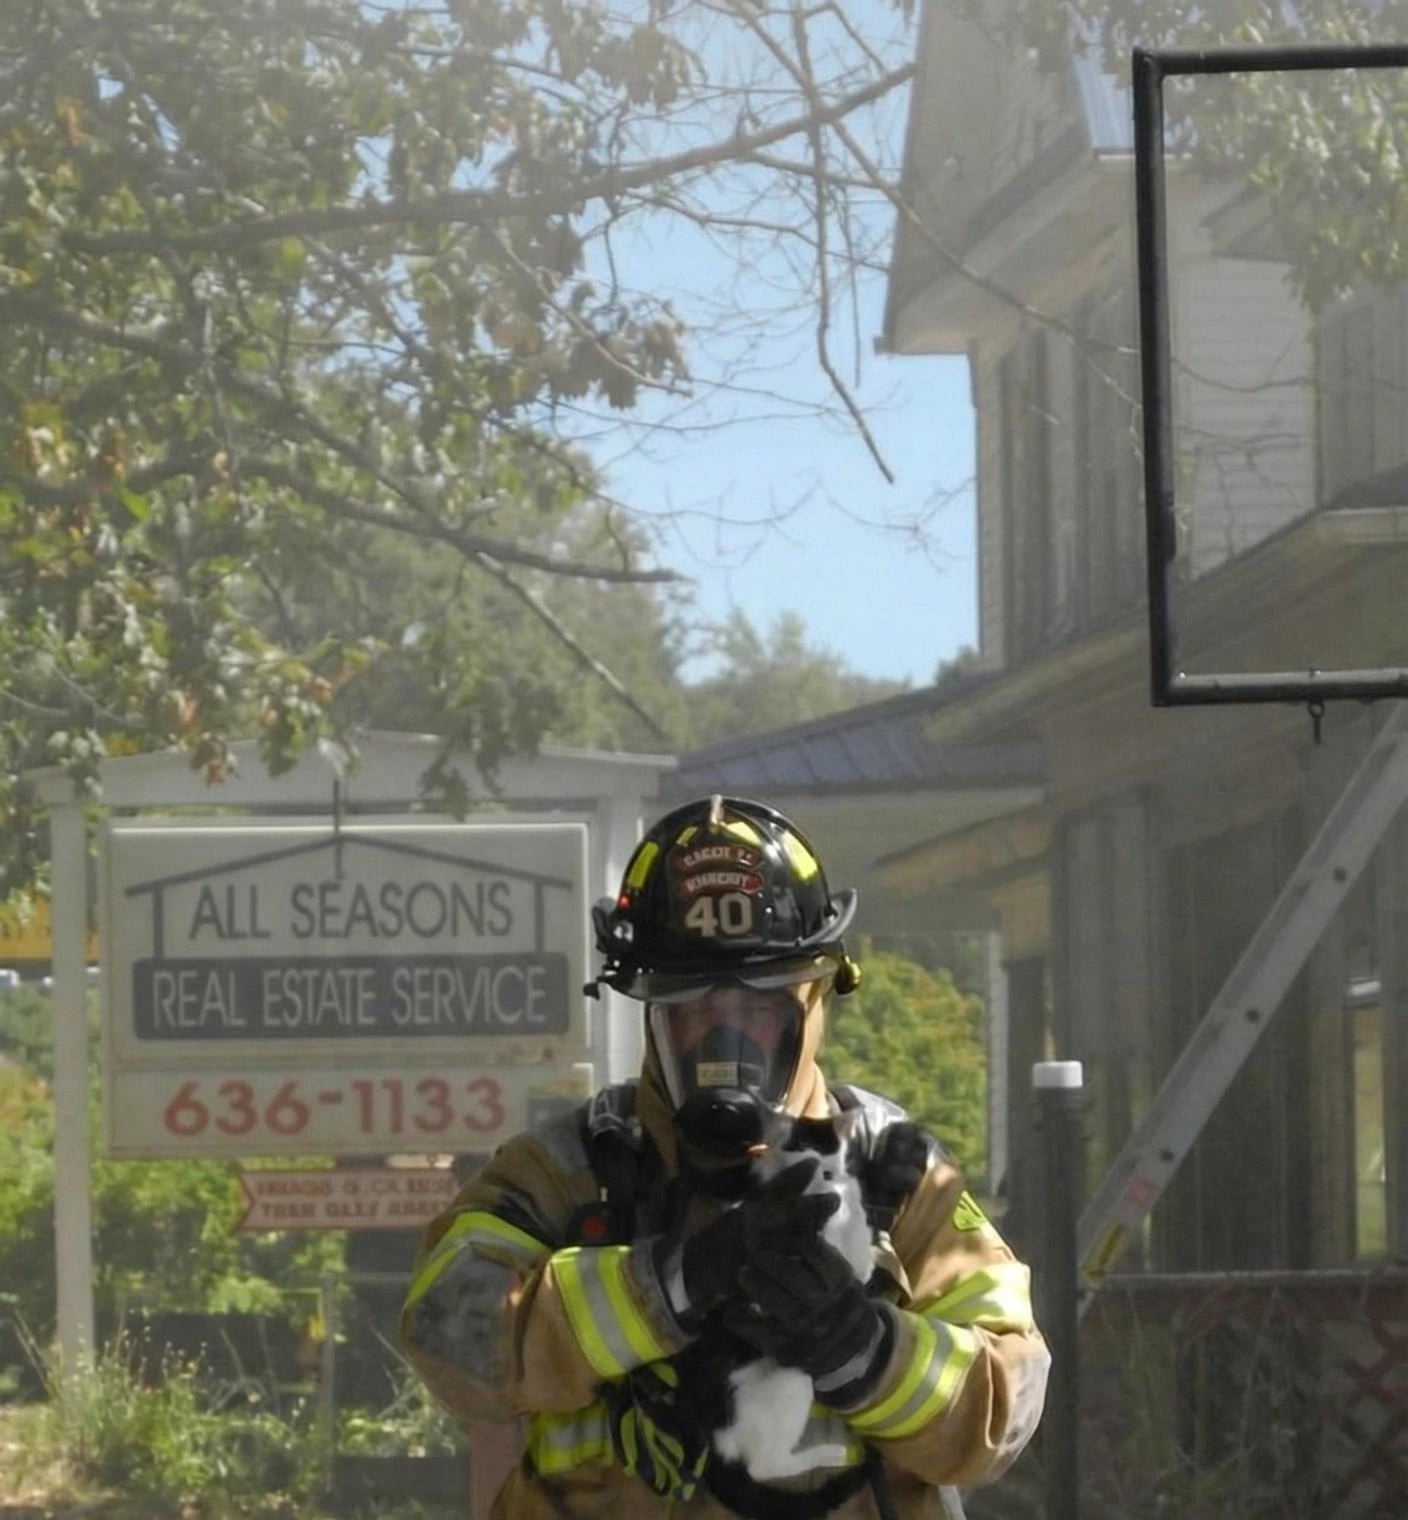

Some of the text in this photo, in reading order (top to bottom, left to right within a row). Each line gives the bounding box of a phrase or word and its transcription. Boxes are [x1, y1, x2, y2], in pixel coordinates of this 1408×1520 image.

[189, 880, 514, 940] ALL SEASONS
[685, 892, 752, 937] 40
[152, 966, 547, 1028] REAL ESTATE SERVICE
[163, 1076, 507, 1137] 636-1133
